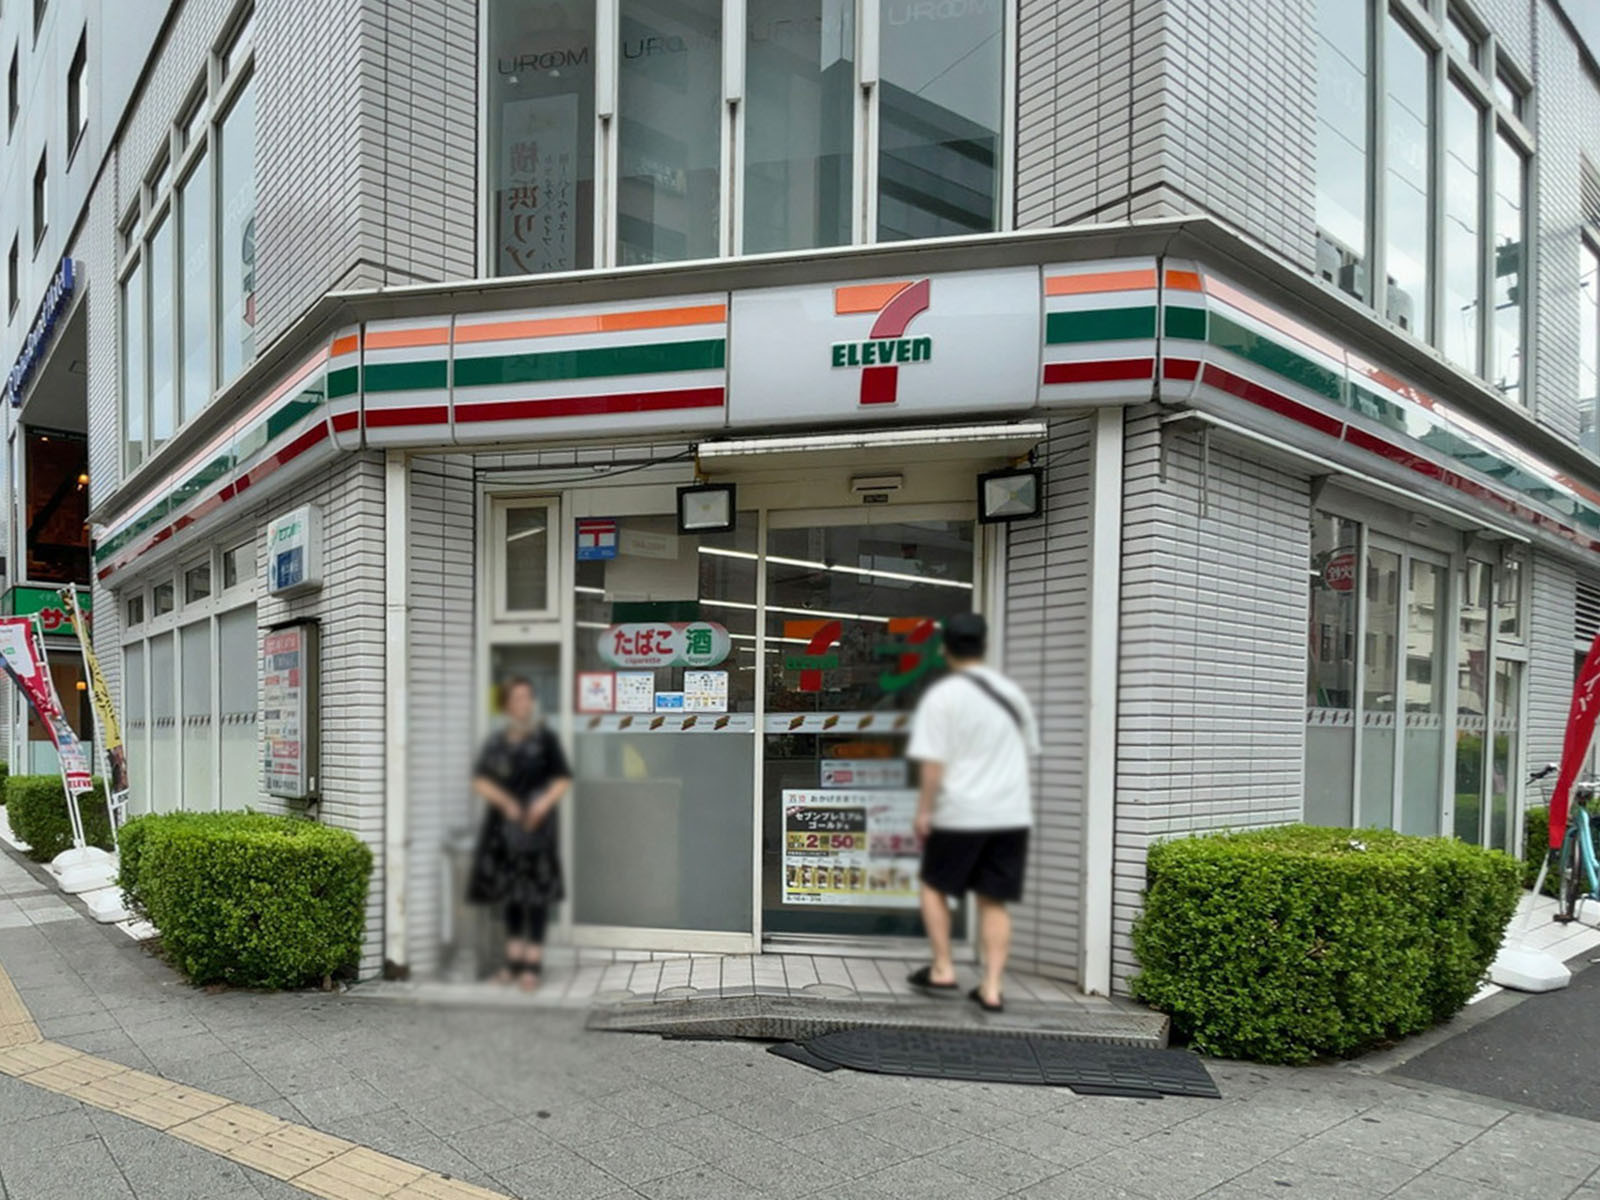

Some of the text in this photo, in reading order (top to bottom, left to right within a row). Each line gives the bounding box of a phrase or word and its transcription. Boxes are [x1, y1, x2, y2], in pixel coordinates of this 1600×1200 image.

[498, 46, 589, 75] UROOM
[614, 629, 712, 655] たばこ 酒
